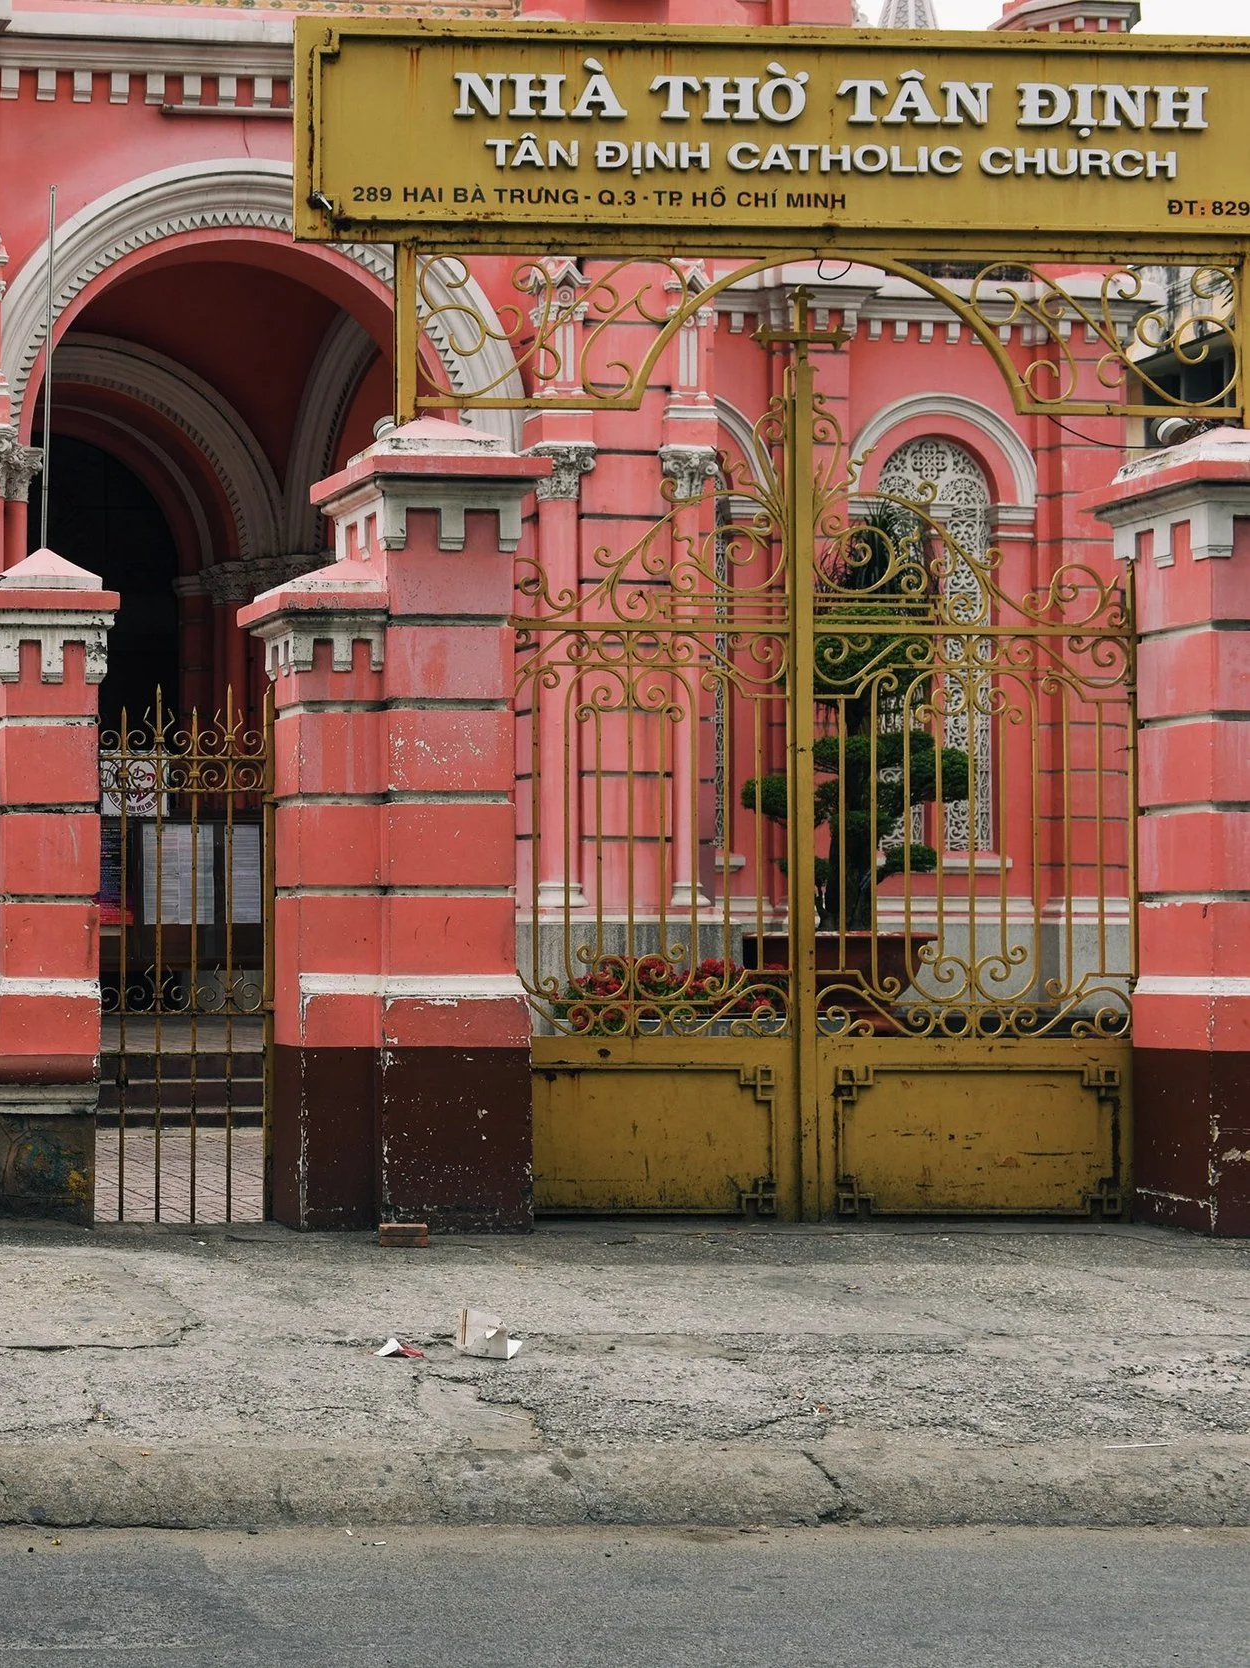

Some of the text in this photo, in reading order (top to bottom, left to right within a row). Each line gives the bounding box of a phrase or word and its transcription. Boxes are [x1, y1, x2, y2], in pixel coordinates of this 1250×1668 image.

[453, 57, 1209, 138] NHÀ THỜ TÂN ĐỊNH
[485, 132, 1178, 179] TÂN ĐỊNH CATHOLIC CHURCH
[352, 186, 392, 202] 289
[403, 187, 443, 203] HAI
[453, 183, 486, 203] BÀ
[493, 186, 579, 205] TRƯNG
[692, 185, 726, 207] HỒ
[736, 188, 777, 208] CHÍ
[786, 193, 846, 209] MINH
[1167, 199, 1250, 216] ĐT: 829
